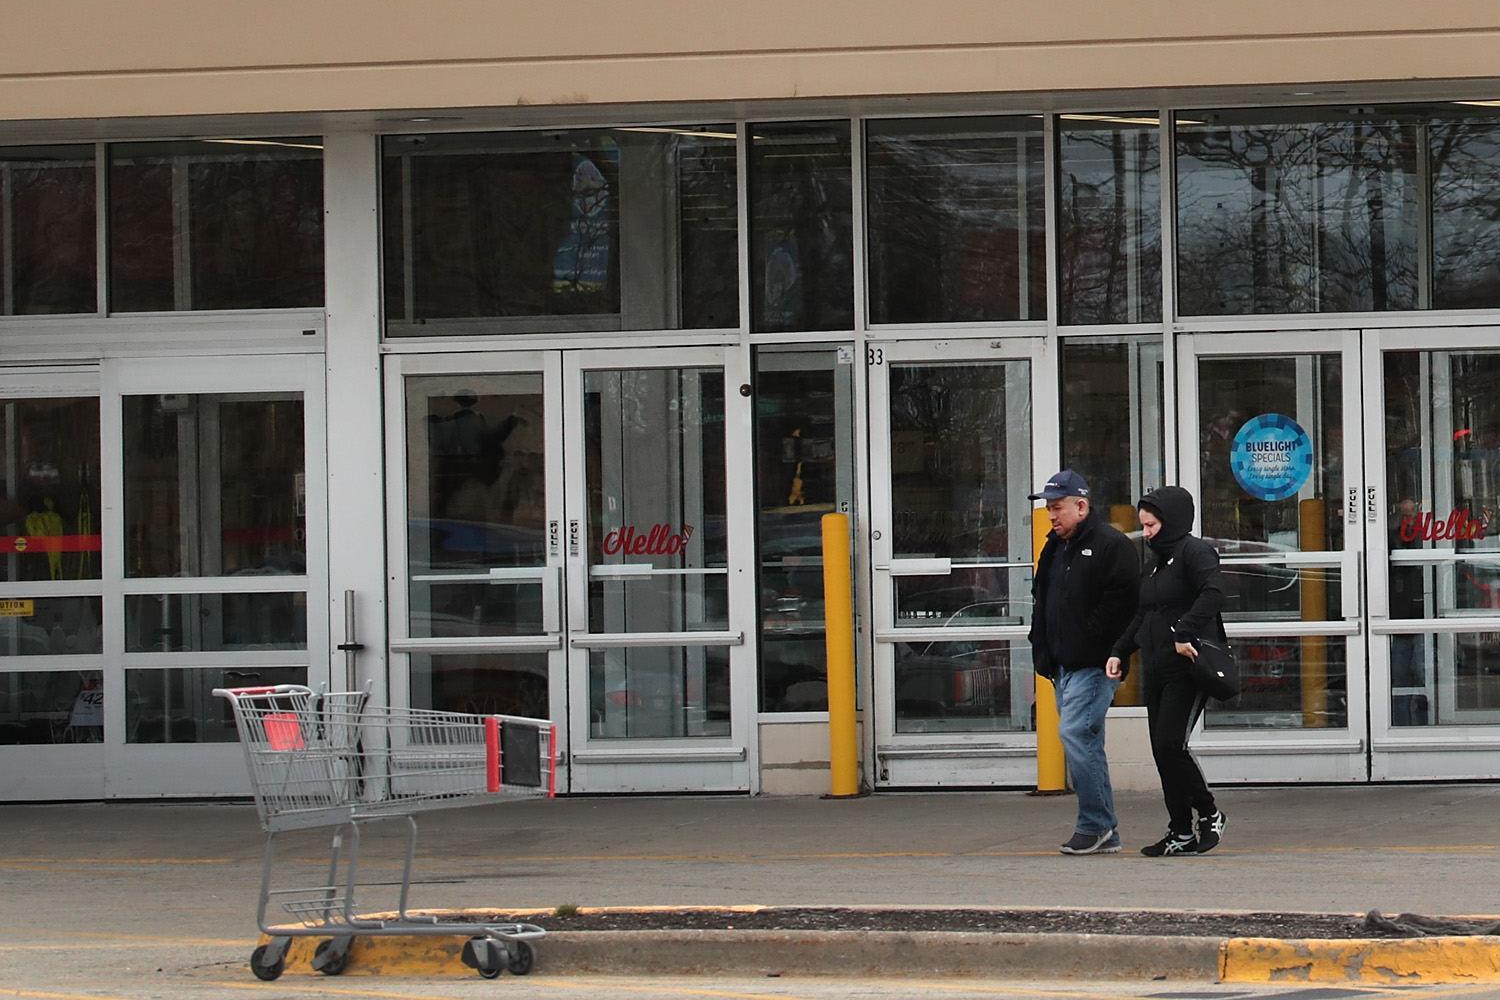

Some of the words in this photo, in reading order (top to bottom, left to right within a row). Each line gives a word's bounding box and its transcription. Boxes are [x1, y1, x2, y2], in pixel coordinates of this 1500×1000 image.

[1245, 441, 1297, 452] BLUELIGHT
[1251, 452, 1292, 463] SPECIALS
[1349, 489, 1357, 513] PULL
[1368, 488, 1376, 512] PULL
[550, 522, 558, 546] PULL
[570, 522, 578, 545] PULL
